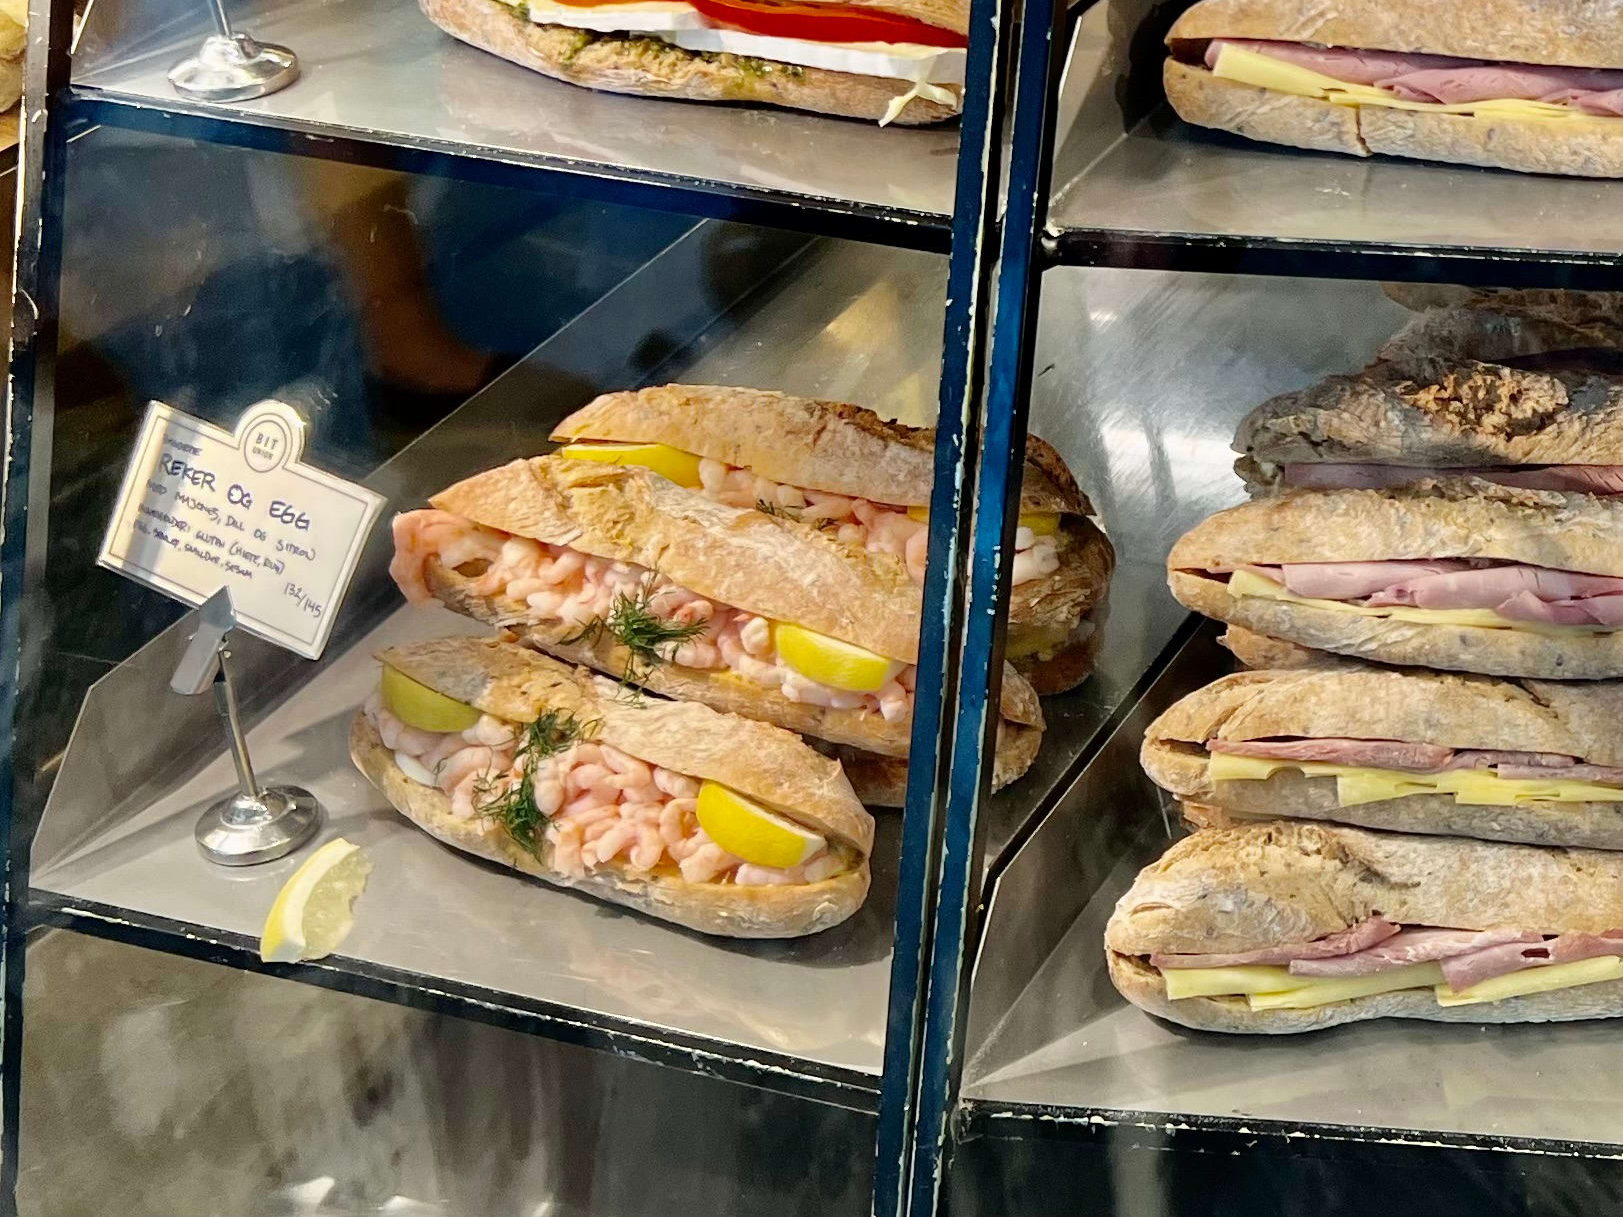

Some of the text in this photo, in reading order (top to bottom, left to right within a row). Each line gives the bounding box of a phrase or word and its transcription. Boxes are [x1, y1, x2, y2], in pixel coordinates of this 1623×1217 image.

[255, 431, 280, 452] BIT
[160, 452, 310, 531] REKER OG EGG
